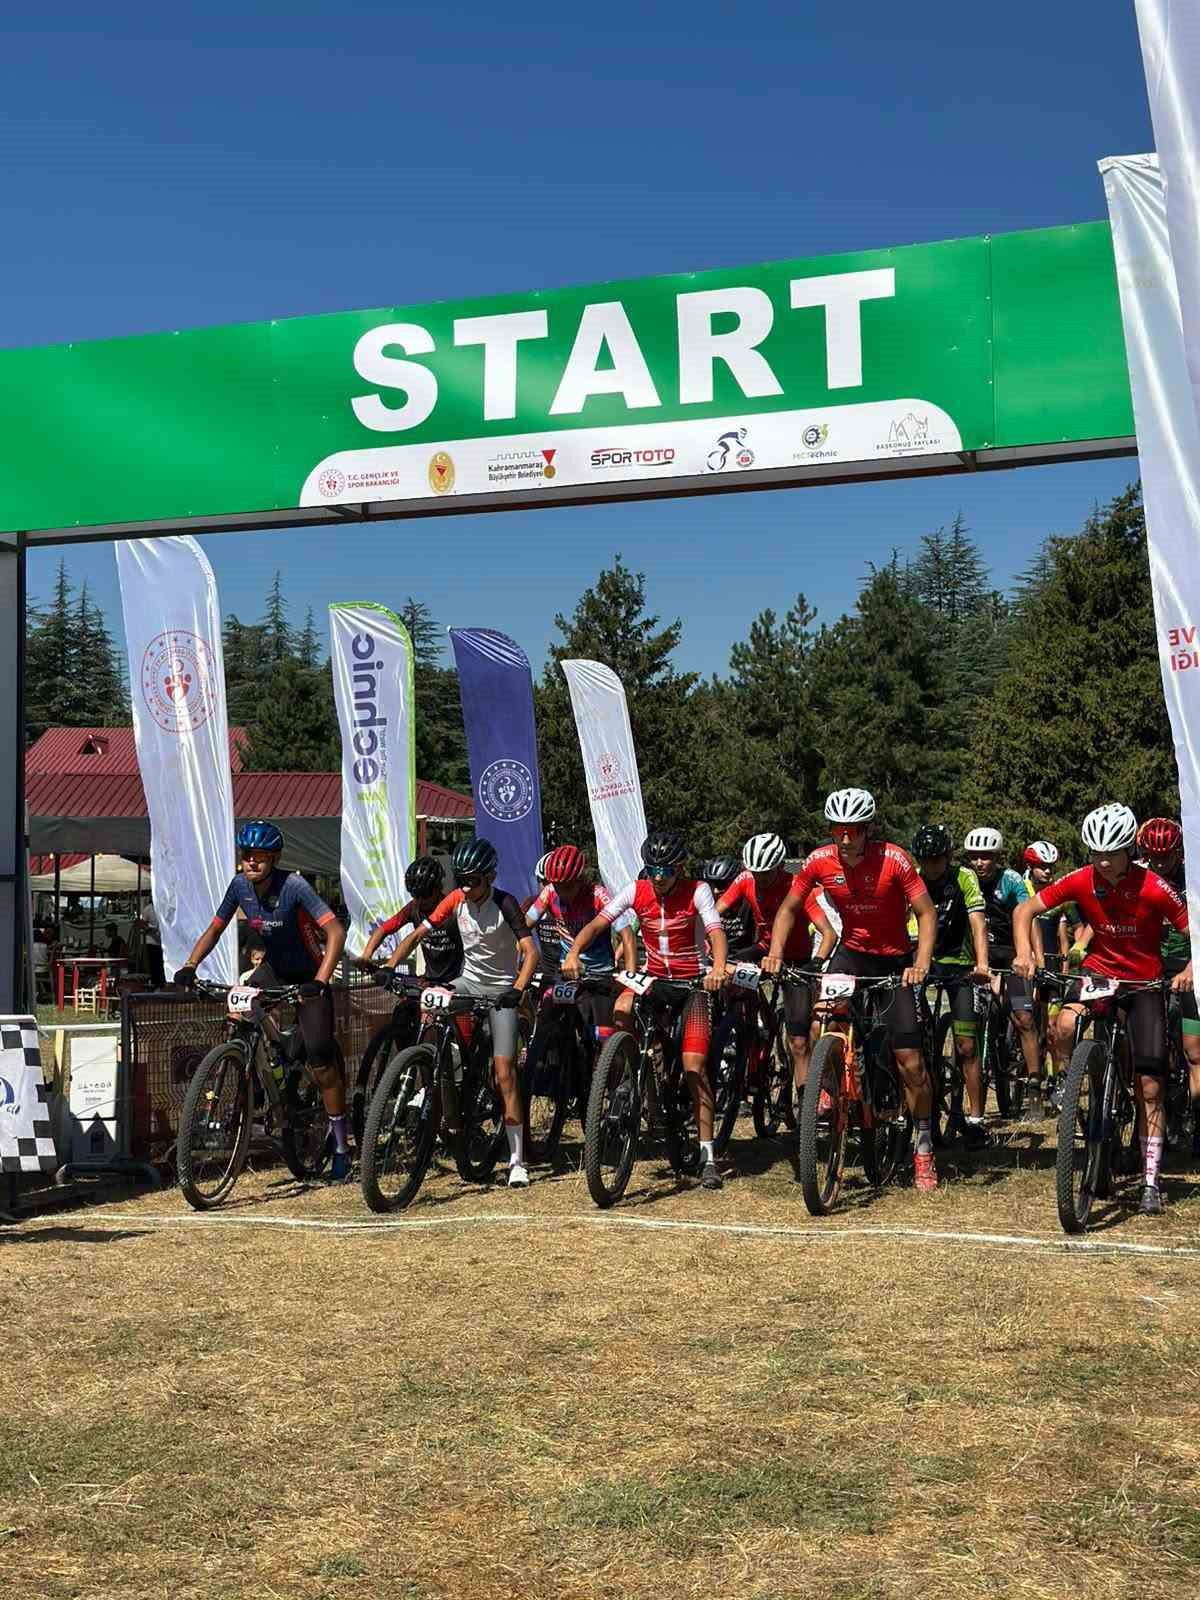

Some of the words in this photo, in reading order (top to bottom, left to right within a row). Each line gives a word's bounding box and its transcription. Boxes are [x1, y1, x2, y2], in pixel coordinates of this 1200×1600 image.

[350, 267, 896, 433] START
[555, 986, 573, 998] 66
[424, 993, 444, 1008] 91
